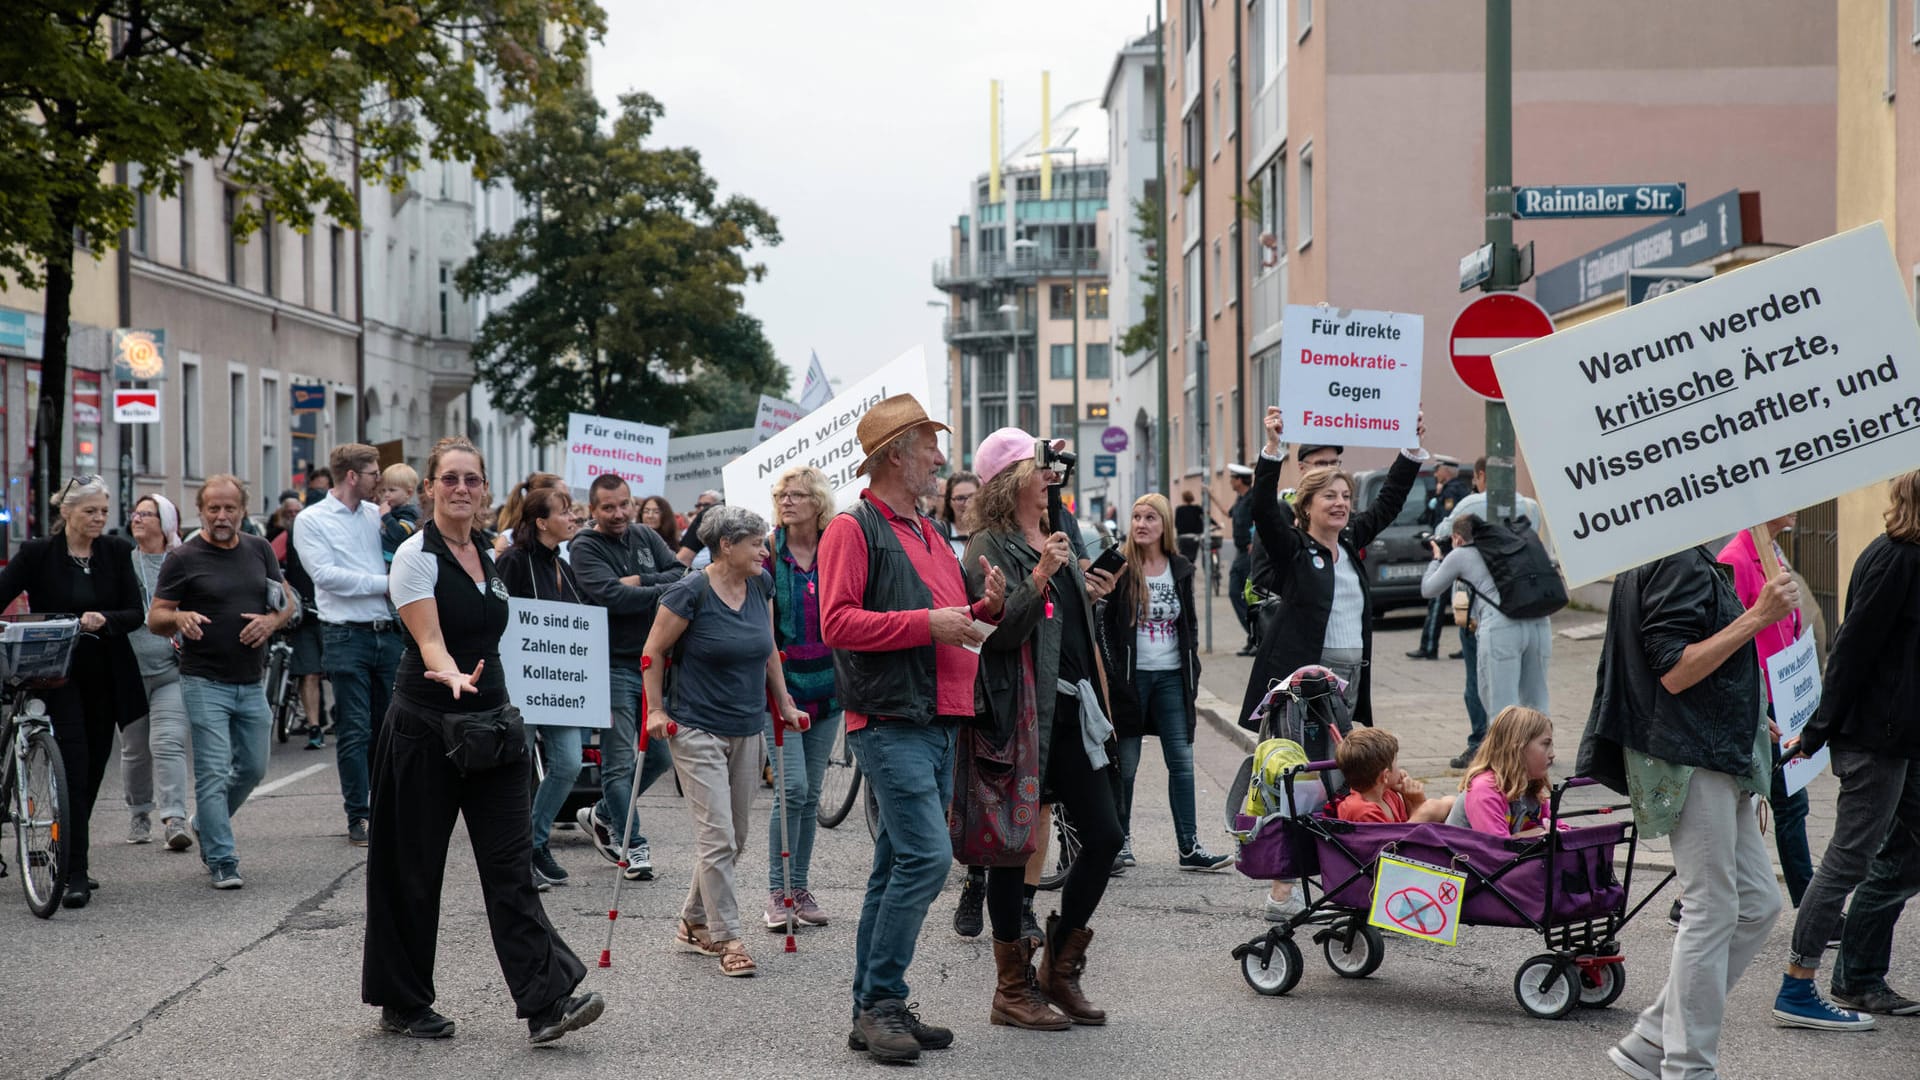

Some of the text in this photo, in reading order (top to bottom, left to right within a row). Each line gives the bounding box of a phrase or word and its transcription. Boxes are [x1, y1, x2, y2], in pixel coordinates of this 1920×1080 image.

[1526, 187, 1674, 212] Raintaler Str.
[1311, 318, 1401, 341] Für direkte
[1578, 287, 1822, 385] Warum werden
[1300, 348, 1397, 370] Demokratie
[1328, 381, 1381, 402] Gegen
[1595, 334, 1839, 432] kritische Ärzte,
[1303, 410, 1400, 431] Faschismus
[1565, 354, 1899, 490] Wissenschaftler, und
[584, 423, 654, 445] Für einen
[758, 385, 887, 479] Nach wieviel
[572, 443, 662, 466] öffentlichen
[667, 449, 705, 463] zweifeln
[706, 448, 721, 458] Sie
[808, 436, 861, 470] fung
[674, 468, 711, 480] zweifeln
[1573, 396, 1920, 540] Journalisten zensiert?
[518, 610, 590, 631] Wo sind die
[521, 637, 588, 657] Zahlen der
[523, 664, 588, 683] Kollateral-
[526, 692, 586, 709] schäden?
